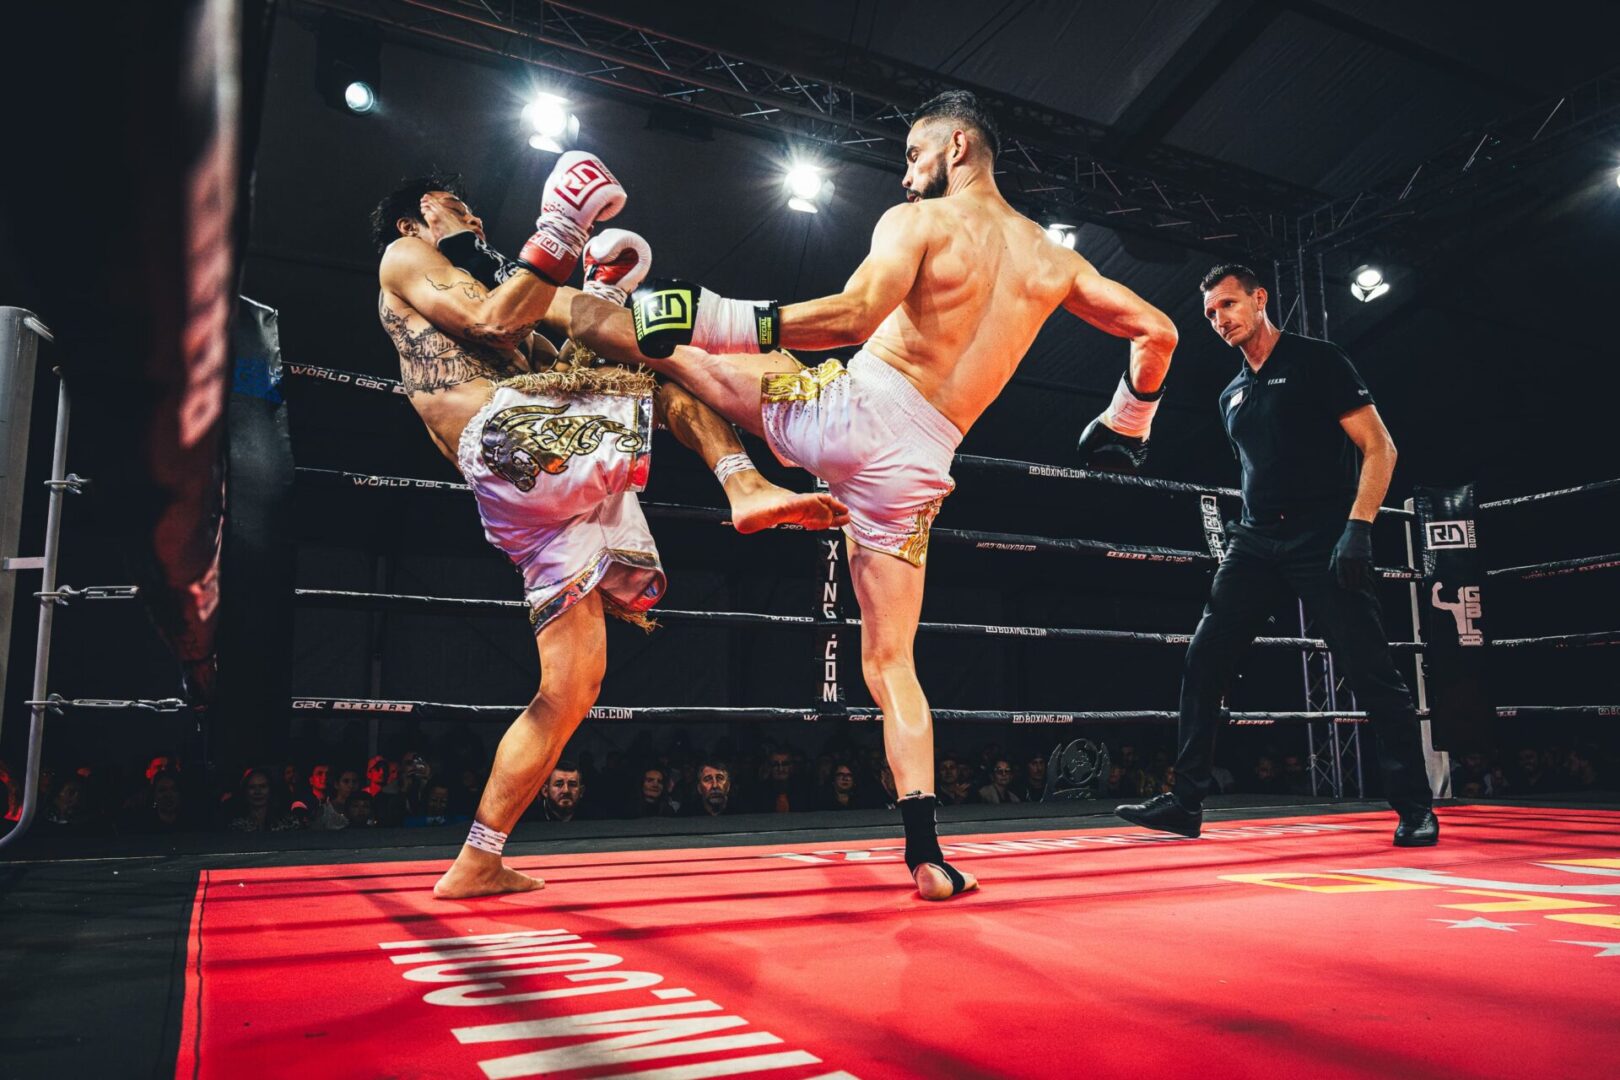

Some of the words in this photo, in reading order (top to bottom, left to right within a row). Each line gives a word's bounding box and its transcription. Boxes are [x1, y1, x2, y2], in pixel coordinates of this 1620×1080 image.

[290, 365, 351, 383] WORLD
[355, 377, 388, 391] GBC
[353, 477, 410, 487] WORLD
[1467, 519, 1477, 549] BOXING
[1166, 635, 1193, 643] WORL
[292, 701, 327, 709] GBC
[349, 702, 398, 711] TOUR
[586, 708, 633, 720] ING.COM
[379, 929, 862, 1080] IM.COM
